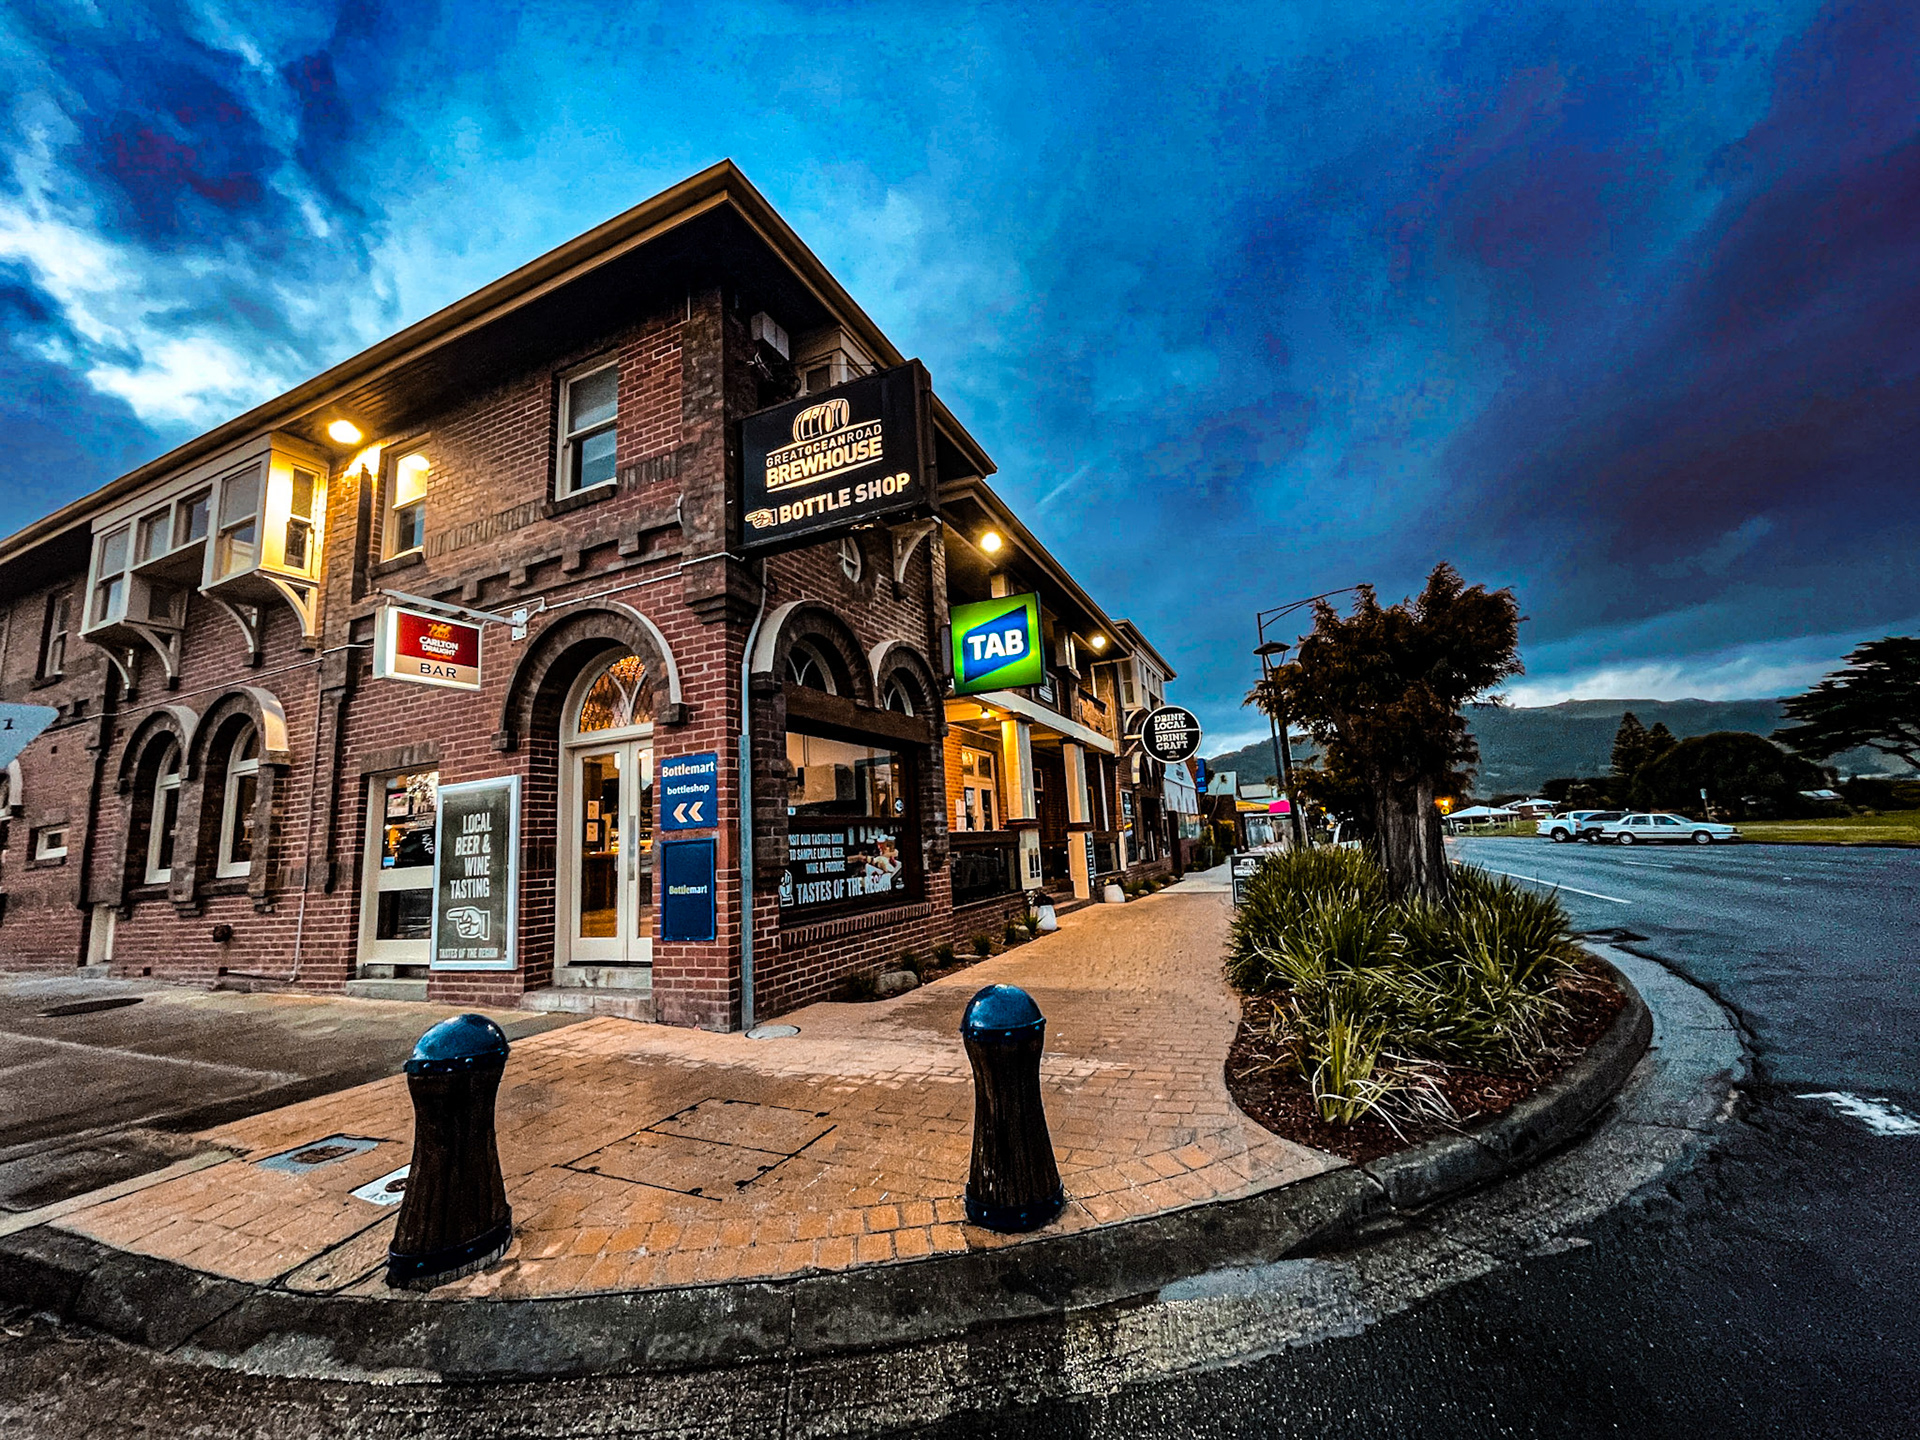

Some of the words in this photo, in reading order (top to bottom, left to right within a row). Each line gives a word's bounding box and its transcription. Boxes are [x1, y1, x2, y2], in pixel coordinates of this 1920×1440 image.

[766, 436, 883, 488] BREWHOUSE
[779, 488, 851, 524] BOTTLE
[854, 473, 911, 503] SHOP
[419, 636, 459, 651] CARLTON
[421, 644, 456, 656] DRAUGHT
[967, 629, 1024, 661] TAB
[420, 663, 457, 678] BAR
[1154, 713, 1186, 723] DRINK
[1154, 721, 1186, 730] LOCAL
[1155, 732, 1188, 743] DRINK
[1156, 741, 1188, 751] CRAFT
[662, 761, 715, 777] Bottlemart
[667, 783, 710, 795] bottleshop
[462, 812, 492, 833] LOCAL
[455, 836, 479, 857] BEER
[481, 834, 491, 854] &
[464, 856, 490, 876] WINE
[450, 878, 490, 900] TASTING
[668, 884, 708, 895] Bottlemart
[796, 880, 832, 905] TASTES
[833, 878, 845, 899] OF
[846, 877, 863, 897] THE
